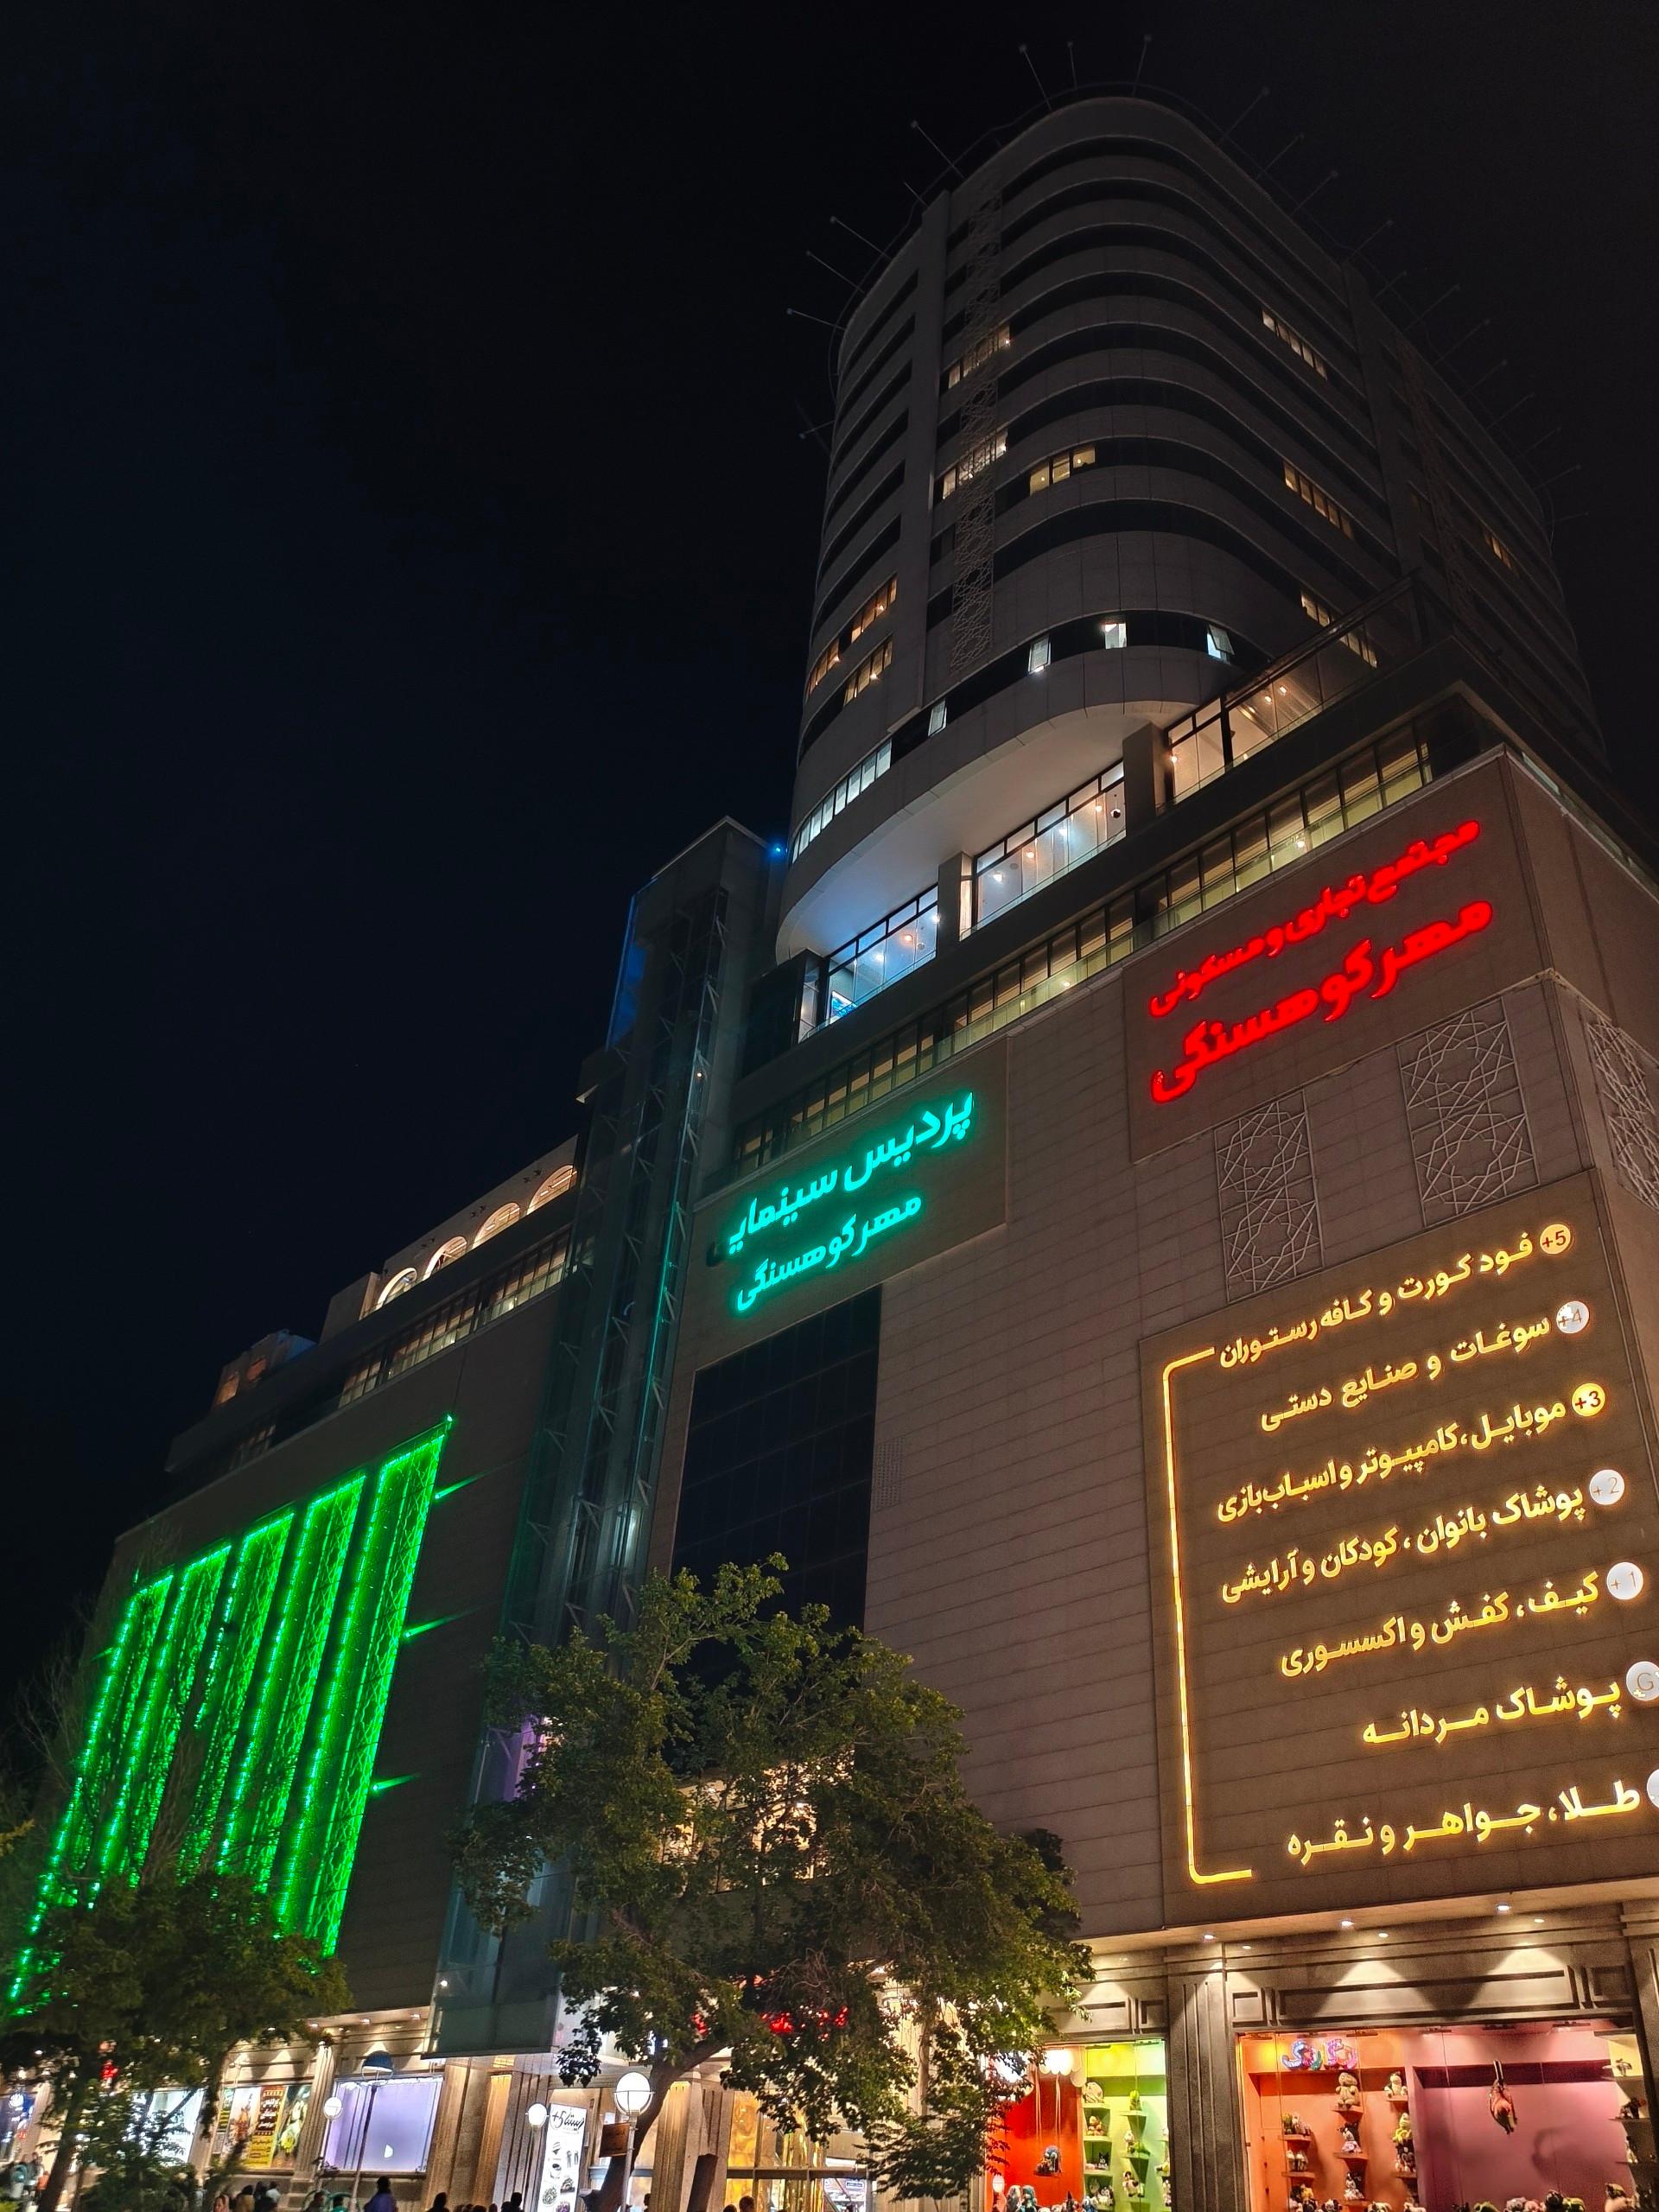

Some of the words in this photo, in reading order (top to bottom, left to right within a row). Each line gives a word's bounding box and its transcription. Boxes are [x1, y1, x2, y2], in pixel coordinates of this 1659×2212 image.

[1368, 820, 1479, 904] مجتمع
[1286, 874, 1367, 944] تجاری
[1265, 927, 1286, 957] و
[1149, 937, 1266, 1018] مسکونی
[843, 1091, 974, 1192] پردیس
[1396, 1253, 1472, 1300] کورت
[1478, 1231, 1534, 1276] فود
[1319, 1288, 1374, 1327] کافه
[1378, 1291, 1394, 1316] و
[1219, 1318, 1319, 1369] رستوران
[1449, 1317, 1551, 1363] سوغات
[1341, 1361, 1418, 1409] صنایع
[1426, 1354, 1443, 1382] و
[1261, 1387, 1333, 1433] دستی
[1355, 1421, 1459, 1485] کامپیوتر
[1339, 1464, 1354, 1491] و
[1591, 1473, 1622, 1500] +2
[1491, 1484, 1587, 1527] پوشاک
[1302, 1560, 1316, 1586] و
[1319, 1525, 1399, 1579] کودکان
[1221, 1547, 1300, 1605] آرایشی
[1410, 1621, 1427, 1651] و
[1431, 1590, 1510, 1645] کفش
[1281, 1616, 1407, 1678] اکسسوری
[1496, 1675, 1623, 1720] پوشاک
[1363, 1707, 1491, 1745] مردانه
[1287, 1816, 1374, 1866] نقره
[1380, 1823, 1396, 1856] و
[1402, 1802, 1542, 1852] جواهر
